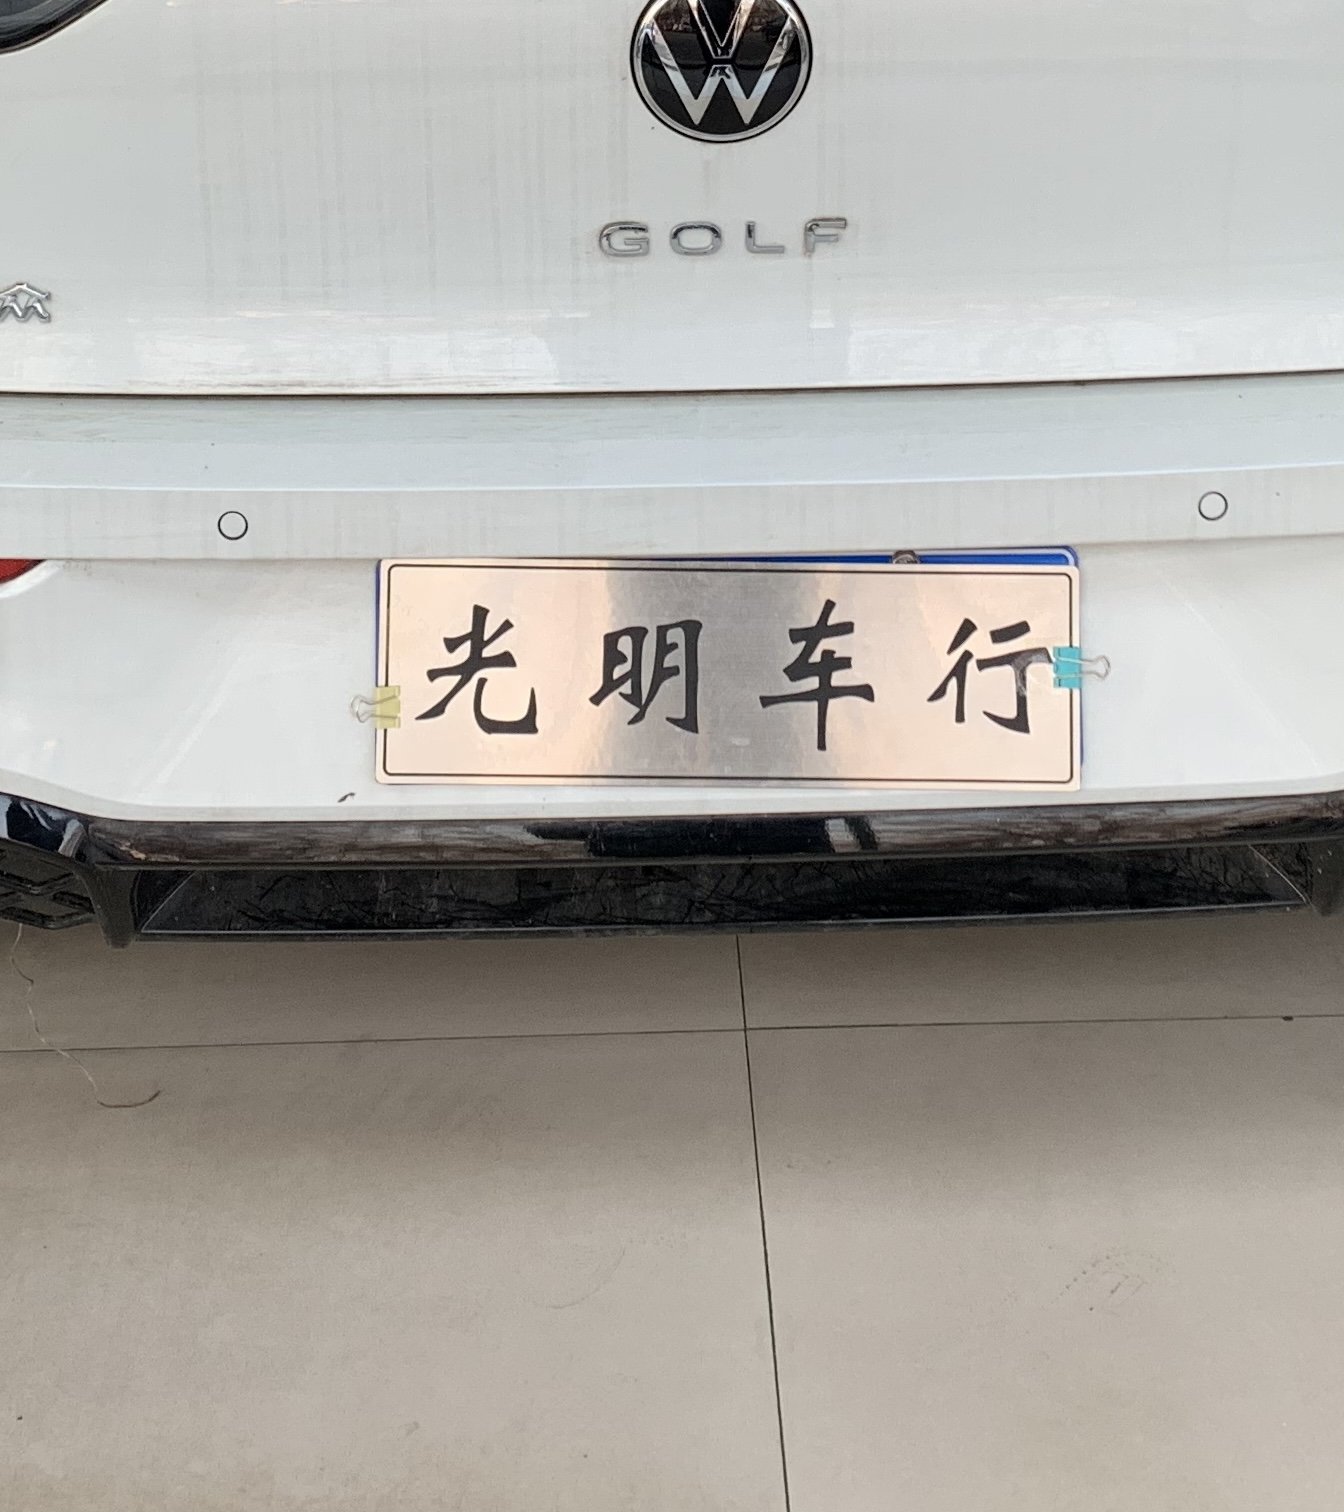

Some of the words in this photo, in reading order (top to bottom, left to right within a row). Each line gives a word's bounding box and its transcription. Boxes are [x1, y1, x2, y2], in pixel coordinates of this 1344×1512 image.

[597, 216, 850, 258] GOLF
[414, 597, 1057, 752] 光明车行
